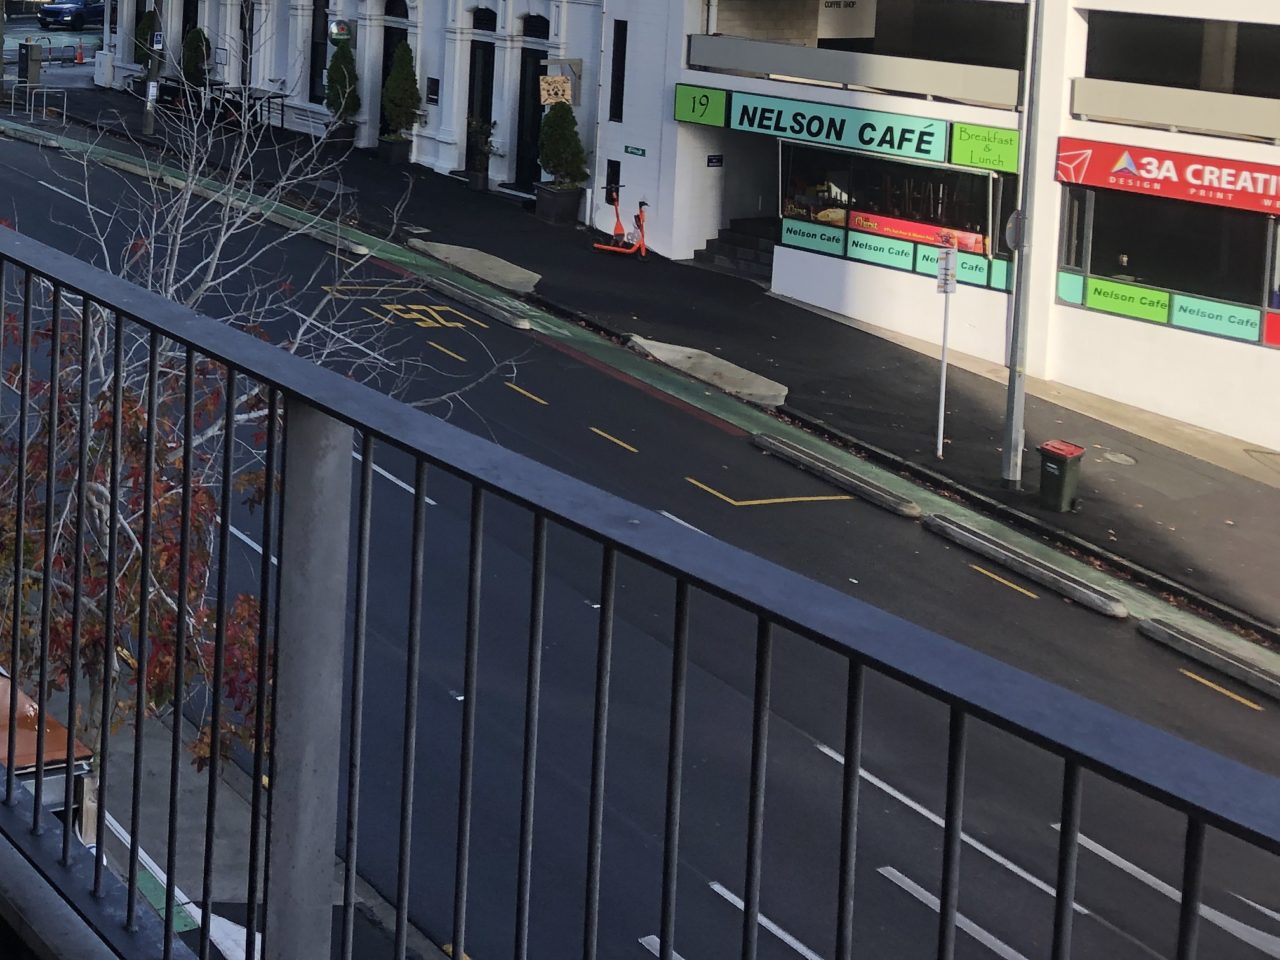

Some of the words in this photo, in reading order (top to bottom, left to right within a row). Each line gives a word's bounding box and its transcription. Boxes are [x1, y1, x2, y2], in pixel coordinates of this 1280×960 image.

[691, 94, 710, 118] 19
[738, 104, 847, 141] NELSON
[857, 122, 935, 155] CAFÉ
[959, 126, 1014, 147] Breakfast
[983, 144, 992, 152] &
[970, 150, 1004, 167] Lunch
[1139, 156, 1179, 182] 3A
[1185, 163, 1280, 197] CREATI
[1109, 176, 1161, 190] DESIGN
[1189, 188, 1233, 201] PRINT
[785, 226, 817, 240] Nelson
[851, 240, 885, 253] Nelson
[1093, 287, 1135, 304] Nelson
[1178, 304, 1223, 322] Nelson
